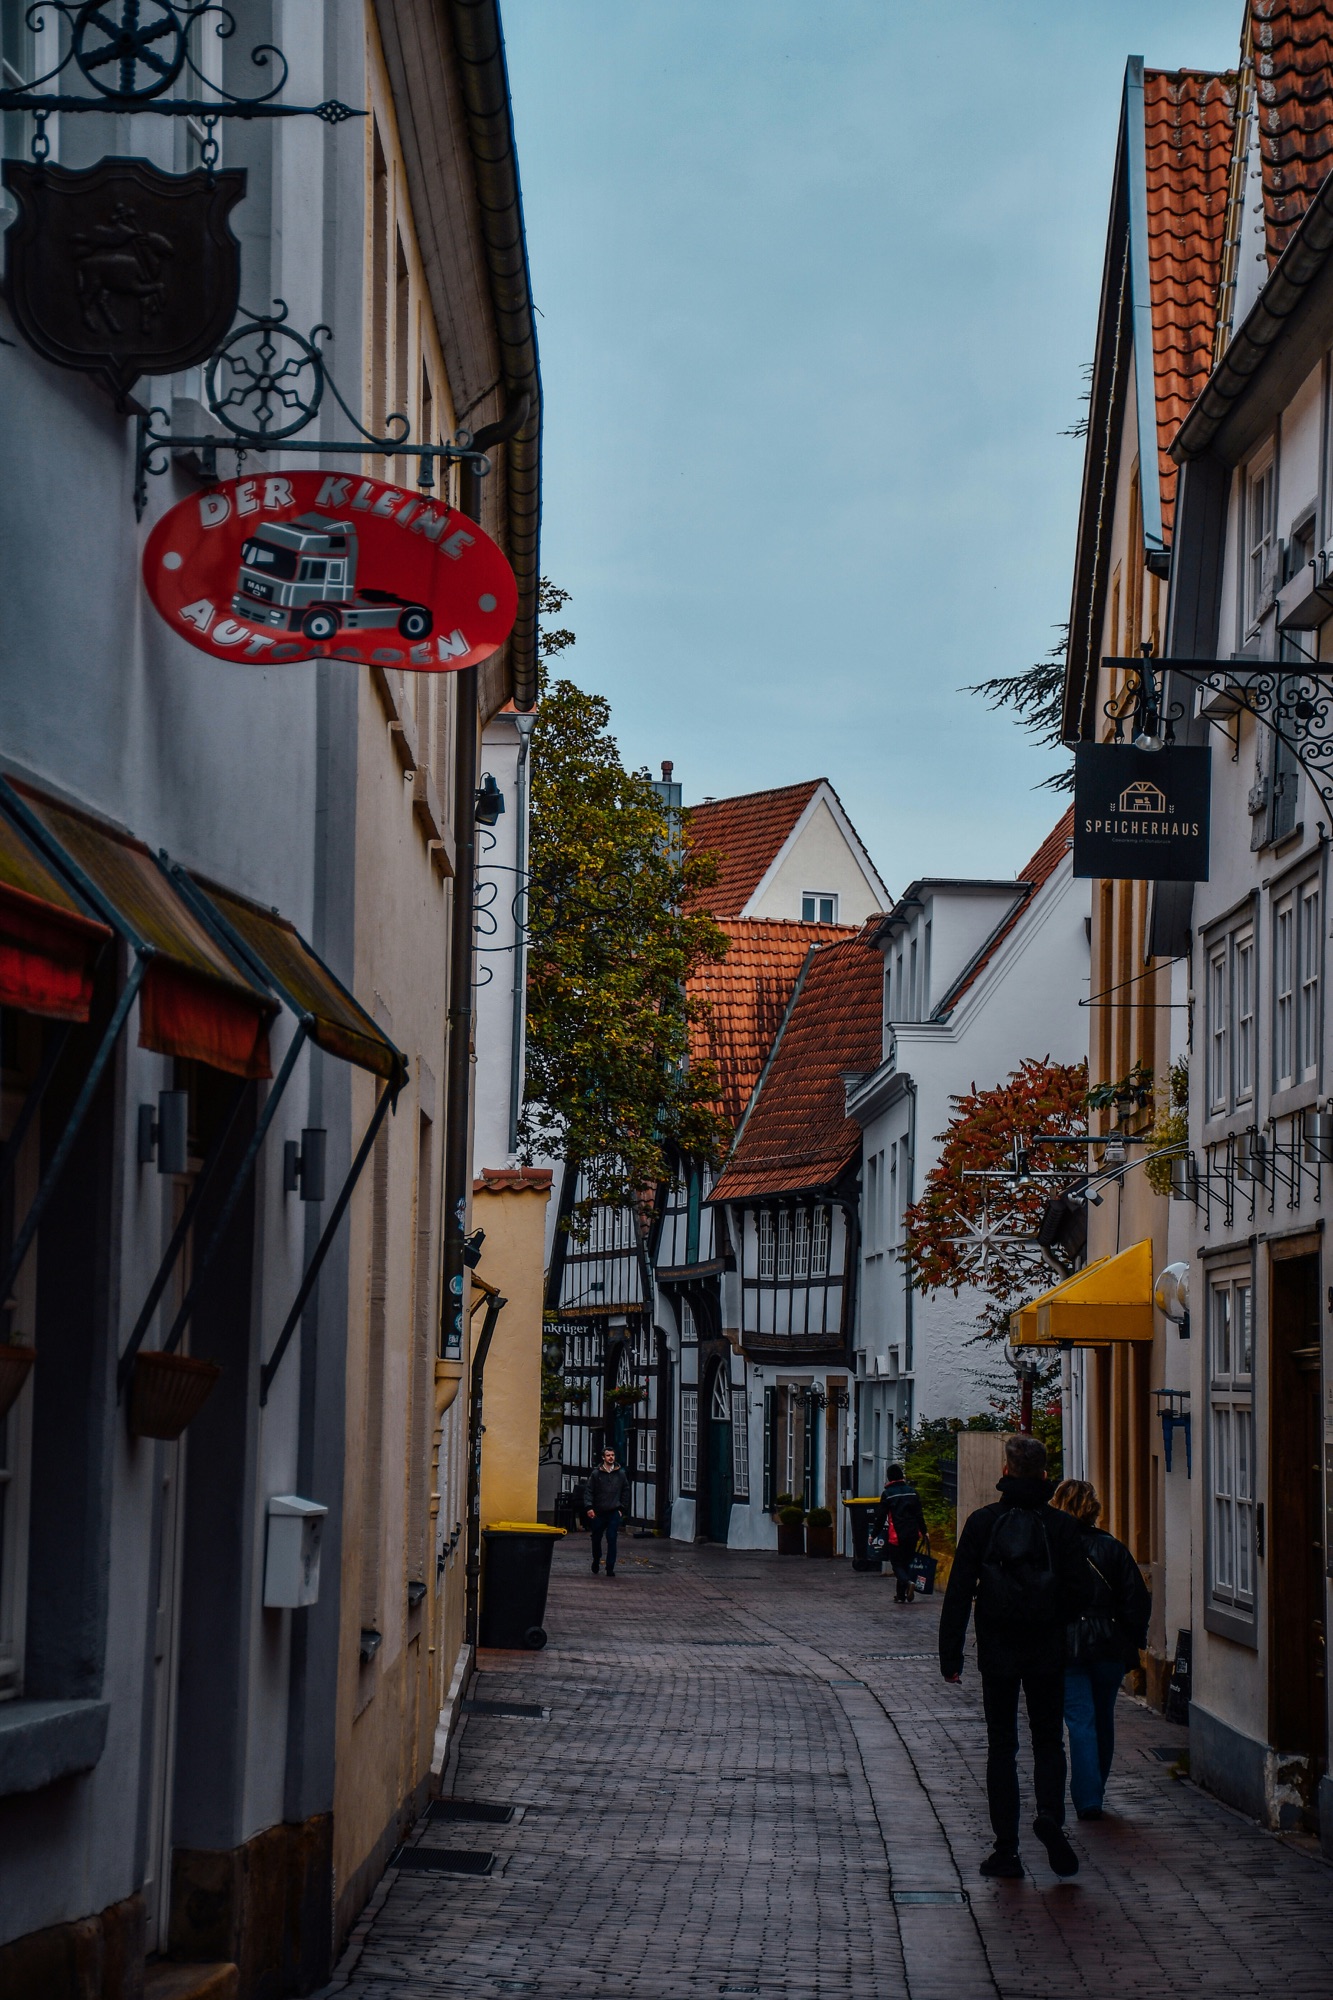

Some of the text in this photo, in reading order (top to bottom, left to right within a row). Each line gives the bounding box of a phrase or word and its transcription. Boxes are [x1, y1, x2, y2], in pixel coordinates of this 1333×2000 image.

[199, 475, 476, 561] DER KLEINE
[247, 580, 267, 593] MAN
[1085, 819, 1199, 836] SPEICHERHAUS
[543, 1322, 589, 1336] nkrüger
